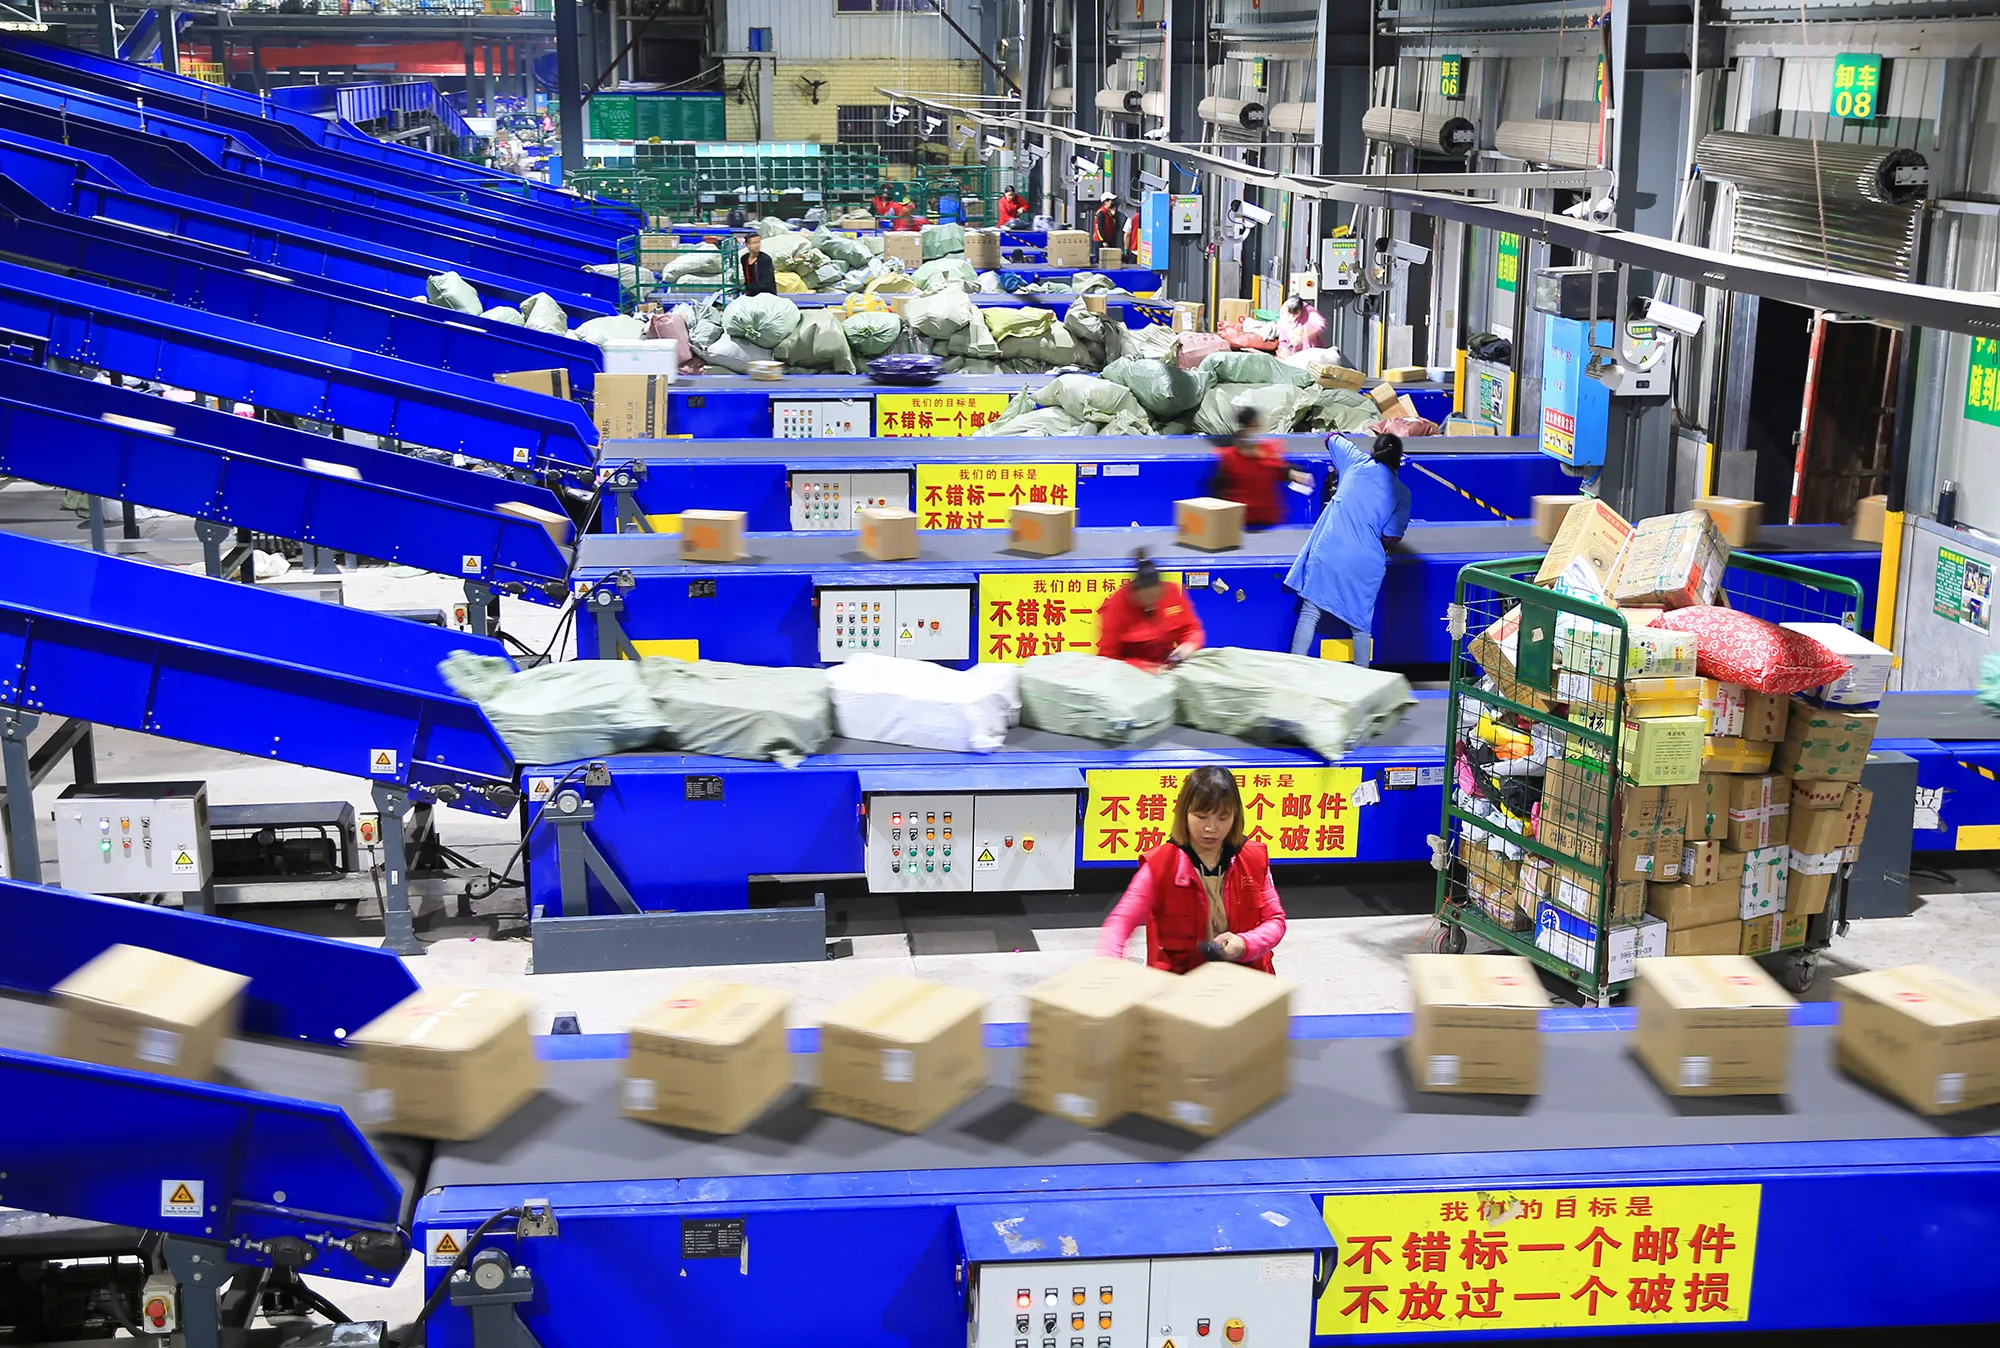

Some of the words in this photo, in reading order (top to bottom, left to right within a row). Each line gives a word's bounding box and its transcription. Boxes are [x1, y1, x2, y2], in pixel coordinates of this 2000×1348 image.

[1441, 61, 1459, 78] 卸车
[1835, 64, 1877, 91] 卸车
[1441, 79, 1457, 96] 06
[1835, 91, 1872, 118] 08
[912, 398, 976, 408] 我们的目标是
[959, 469, 1038, 481] 我们的目标是
[924, 484, 1069, 507] 不错标一个邮件
[924, 511, 1012, 530] 不放过一
[989, 599, 1106, 628] 不错标一
[989, 632, 1106, 660] 不放过一
[1159, 773, 1296, 789] 我目标是
[1099, 792, 1348, 823] 不错个邮件
[1098, 824, 1345, 855] 不放个破损
[1342, 1222, 1737, 1275] 不错标一个邮件
[1340, 1272, 1730, 1324] 不放过一个破损
